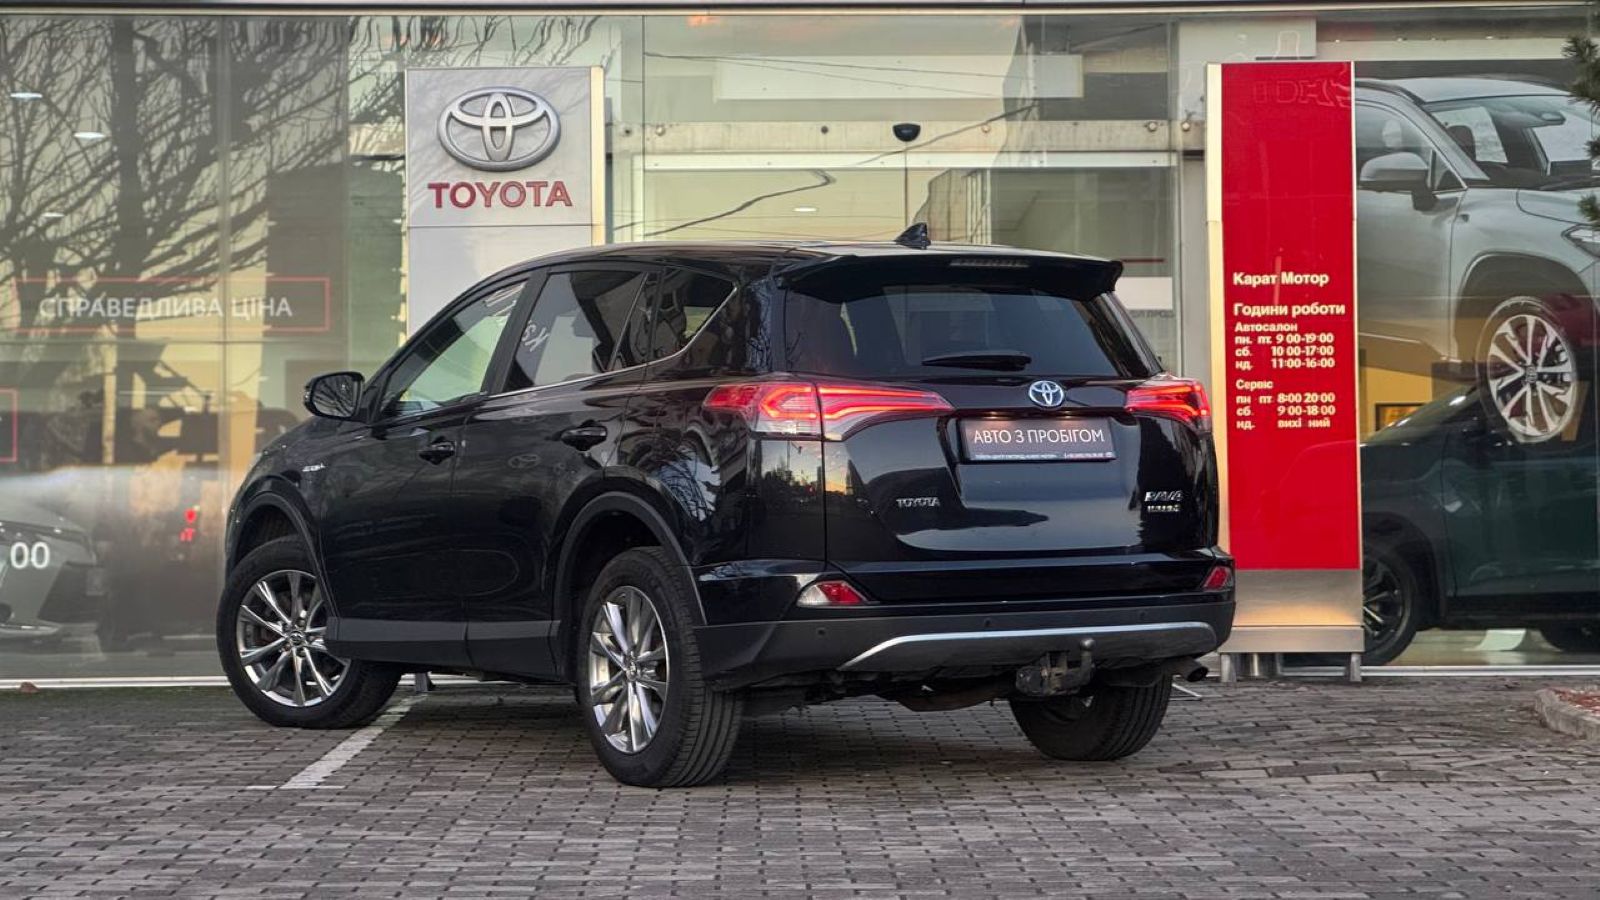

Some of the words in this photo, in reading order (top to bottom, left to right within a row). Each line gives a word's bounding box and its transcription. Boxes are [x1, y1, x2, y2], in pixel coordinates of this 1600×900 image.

[427, 180, 573, 209] TOYOTA
[1232, 271, 1277, 288] Карат
[1280, 271, 1329, 287] Мотор
[38, 296, 223, 318] СПРАВЕДЛИВА
[231, 296, 293, 321] ЦІНА
[1233, 302, 1288, 317] Години
[1291, 301, 1346, 318] роботи
[1234, 322, 1298, 332] Автосалон
[1235, 379, 1274, 391] Сервіс
[974, 429, 1012, 444] АВТО
[1027, 429, 1105, 444] ПРОБІГОМ
[10, 541, 50, 569] 00
